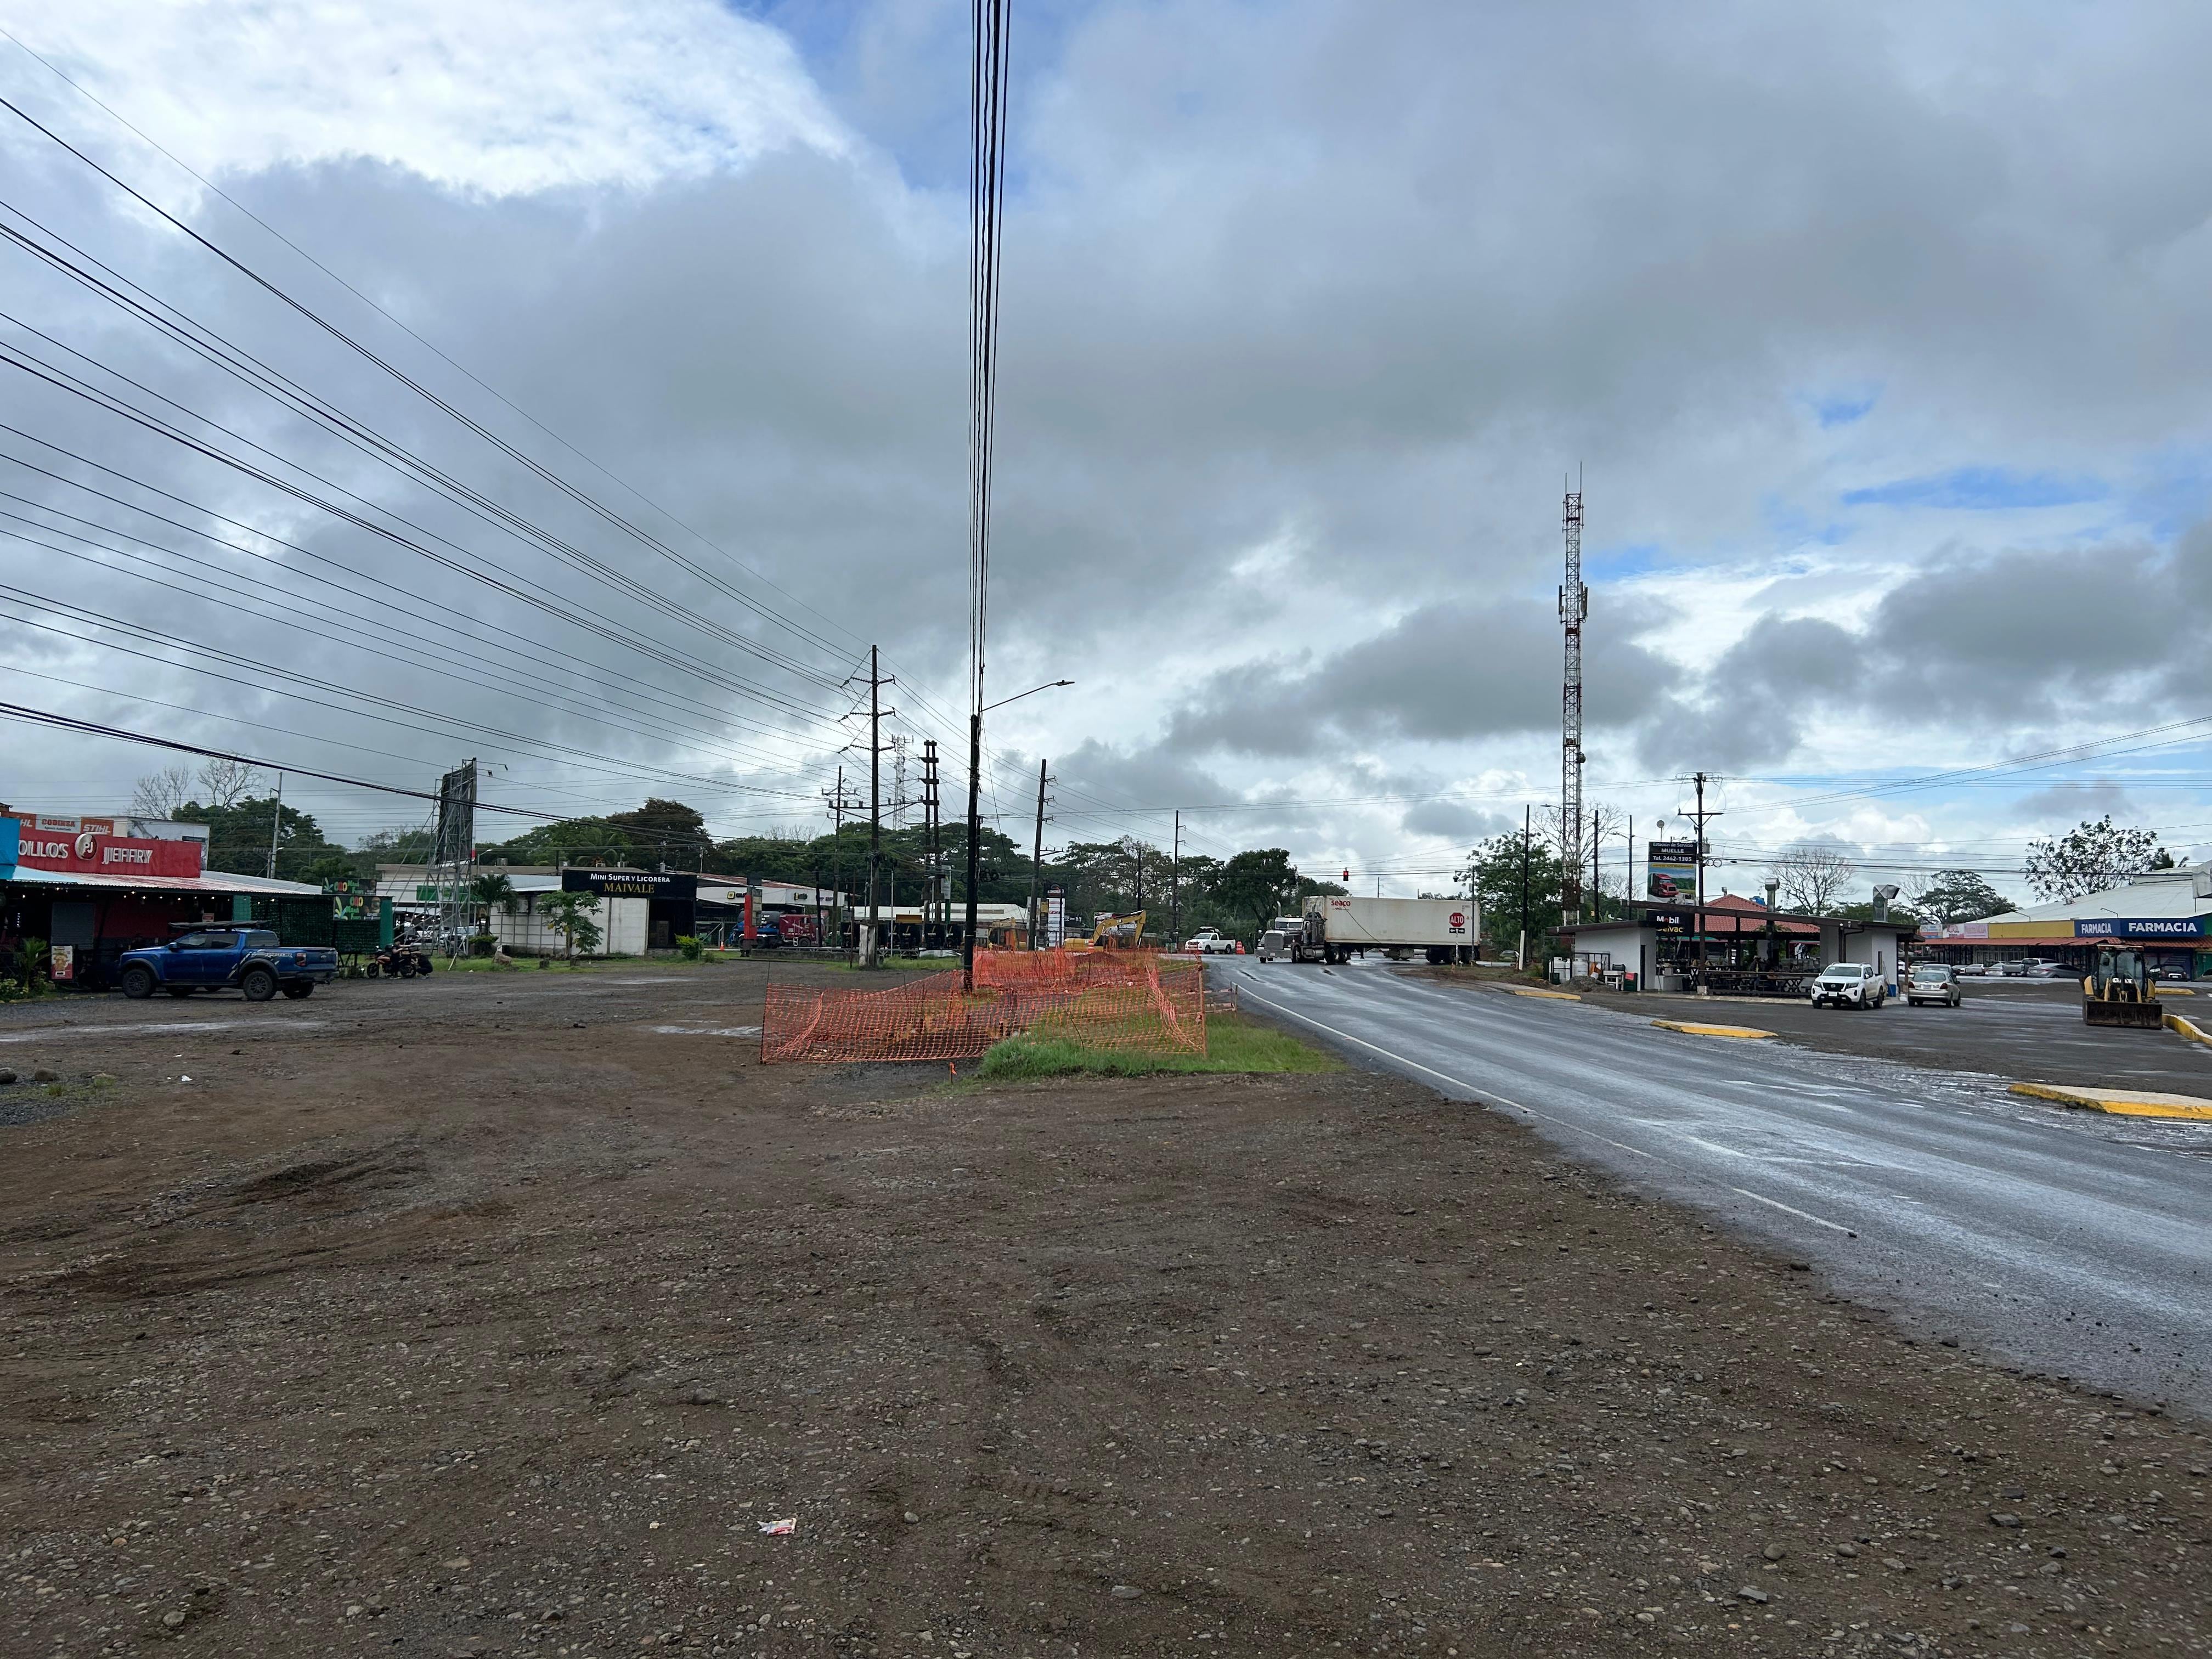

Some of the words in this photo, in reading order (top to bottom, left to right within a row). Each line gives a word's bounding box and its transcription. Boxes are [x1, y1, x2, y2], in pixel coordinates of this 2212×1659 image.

[83, 823, 111, 833] STIHL
[18, 839, 69, 859] OLLOS
[83, 842, 94, 854] PJ
[101, 847, 153, 865] JEFFRY
[603, 883, 655, 893] MAIVALE
[1450, 916, 1464, 924] ALTO
[1656, 916, 1679, 924] Mobil
[2081, 923, 2112, 934] FARMACIA
[2128, 922, 2198, 932] FARMACIA
